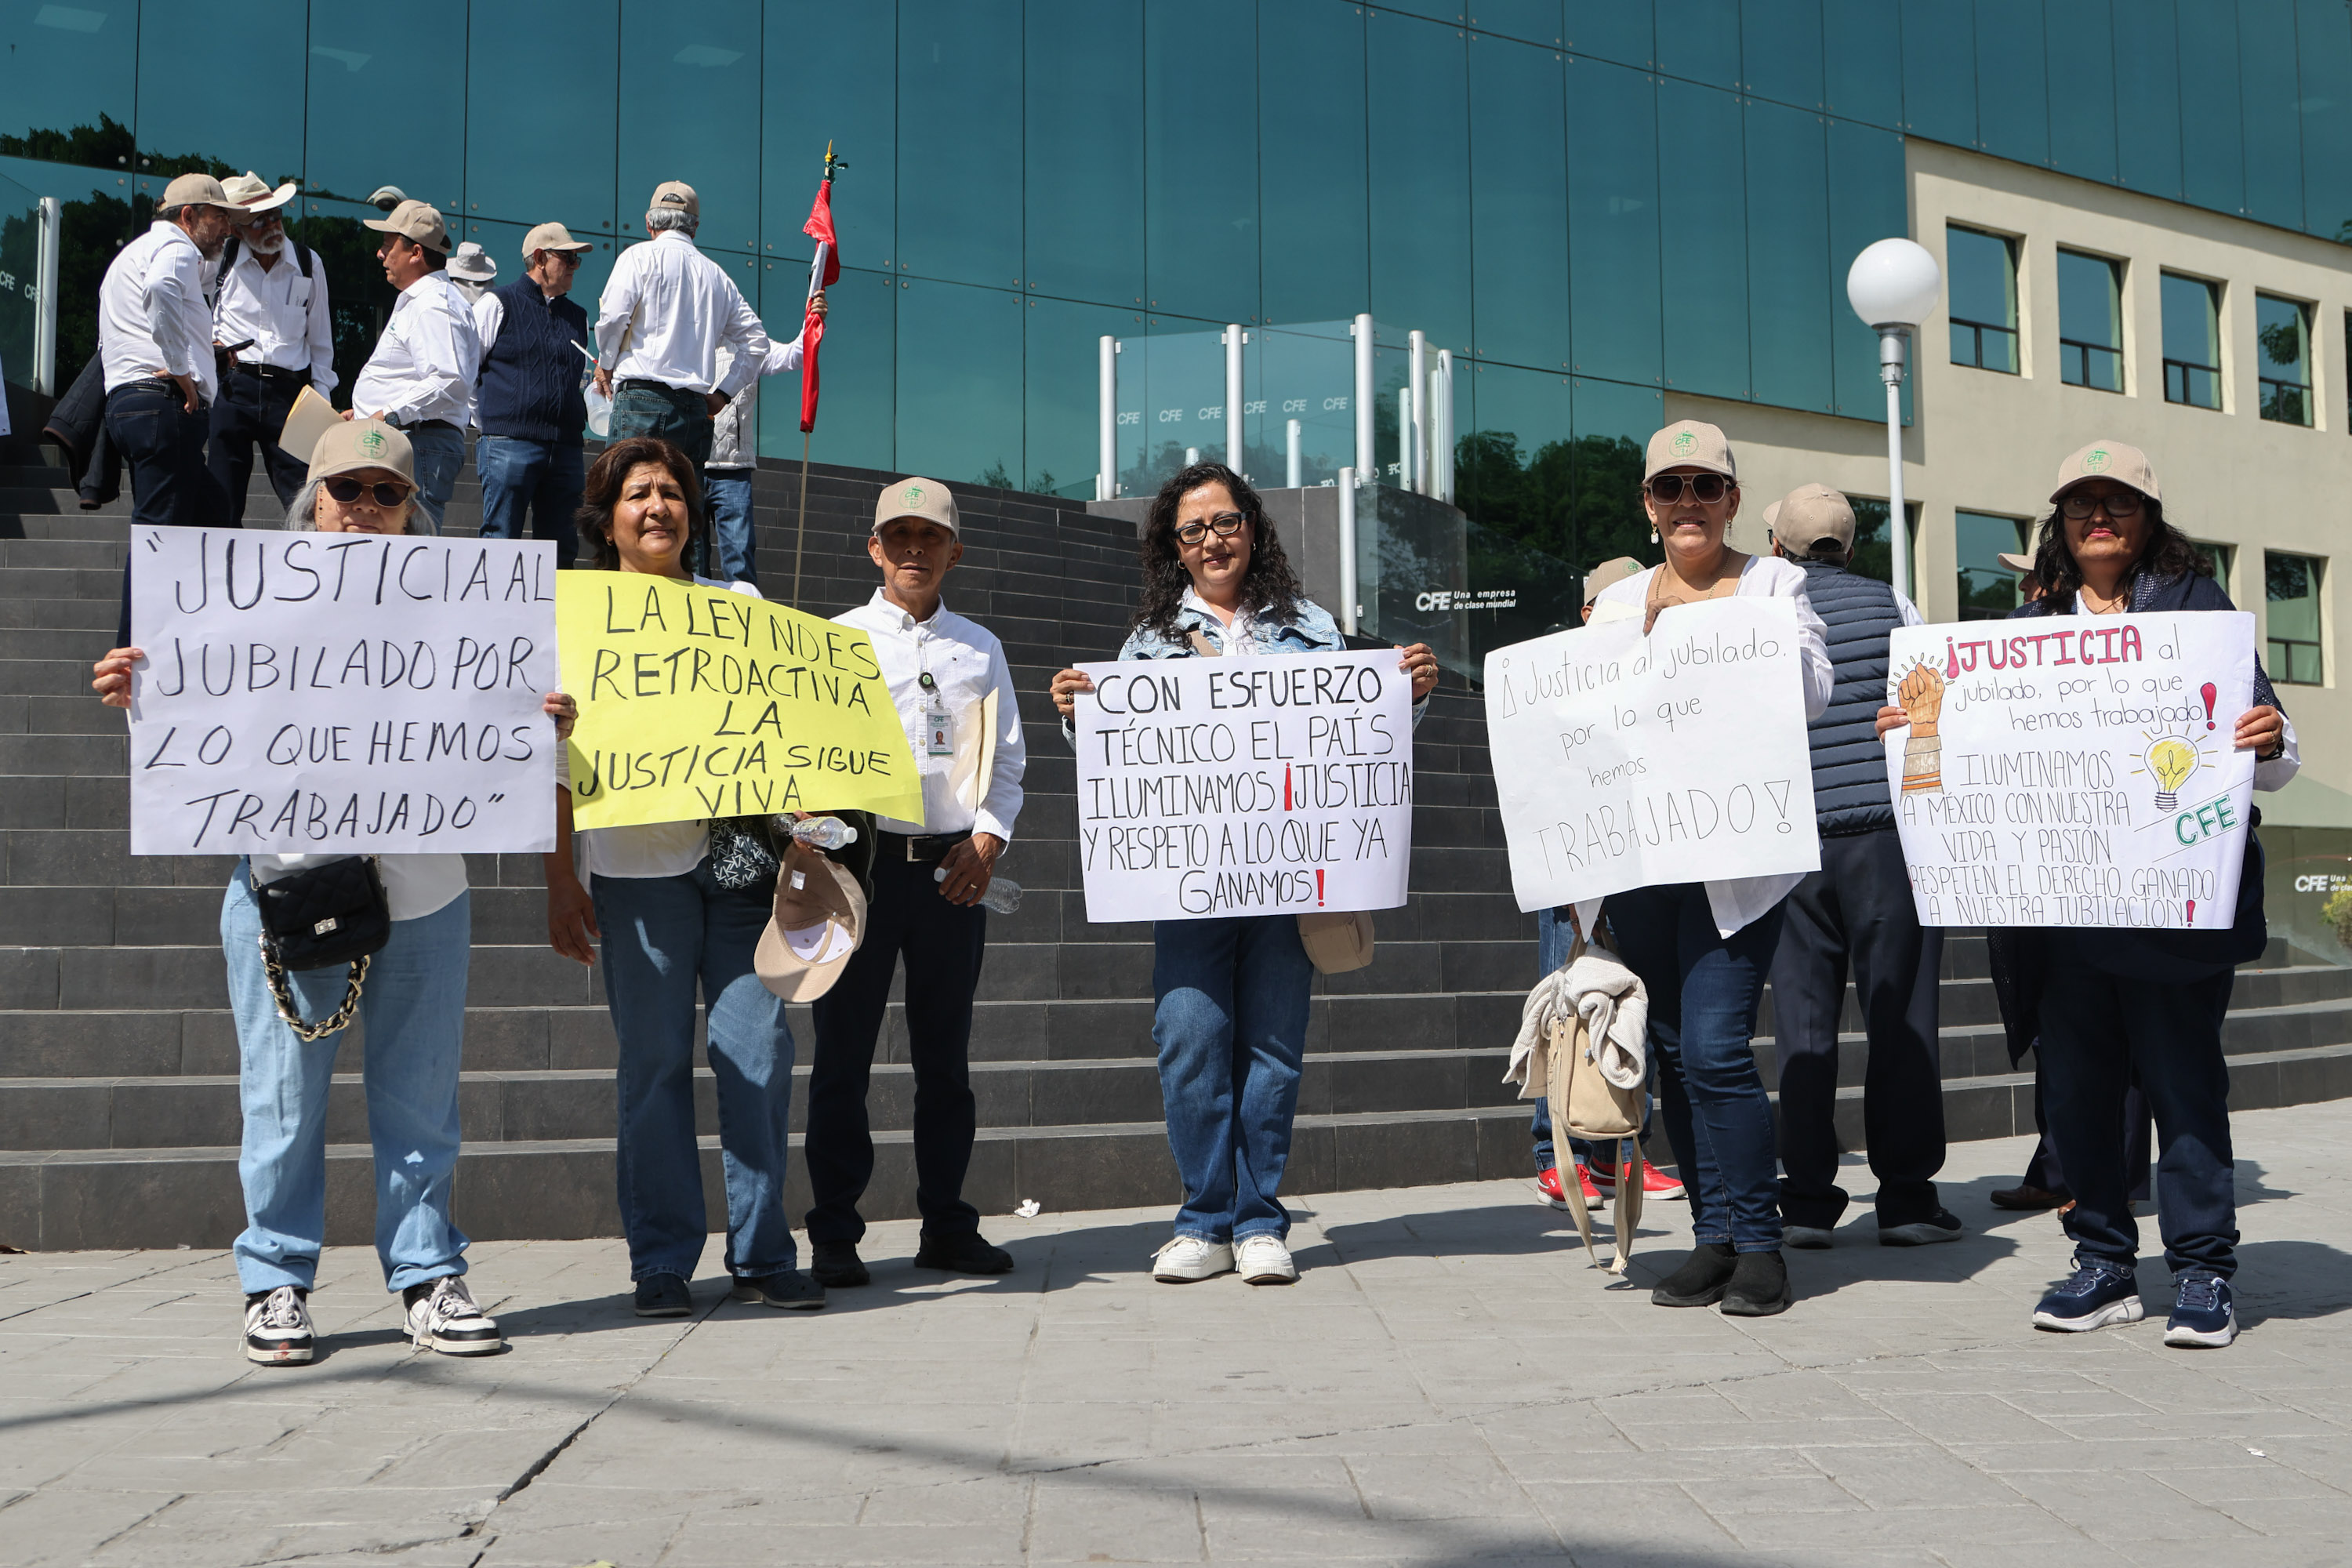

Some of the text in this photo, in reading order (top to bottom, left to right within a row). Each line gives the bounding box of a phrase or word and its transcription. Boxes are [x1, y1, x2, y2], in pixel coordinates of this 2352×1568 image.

[1116, 412, 1141, 425] CFE
[1159, 409, 1183, 423] CFE
[1198, 406, 1222, 420] CFE
[1243, 401, 1267, 414] CFE
[1283, 399, 1307, 412] CFE
[1323, 397, 1348, 410] CFE
[1675, 437, 1691, 445] CFE
[2087, 454, 2103, 463] CFE
[504, 551, 555, 603] AL
[1454, 590, 1515, 600] Una empresa
[1415, 591, 1452, 612] CFE
[1454, 599, 1516, 610] de clase mundial
[606, 586, 666, 633] LA
[686, 593, 752, 647] LEY
[826, 632, 880, 680] ES
[2158, 623, 2181, 661] al
[157, 637, 537, 696] JUBILADO POR
[1633, 636, 1653, 674] al
[590, 646, 871, 717] RETROACTIVA
[1097, 665, 1382, 714] CON ESFUERZO
[2057, 677, 2097, 702] por
[2107, 667, 2129, 694] lo
[2142, 675, 2183, 702] que
[713, 700, 783, 739] LA
[1095, 708, 1394, 766] TÉCNICO EL PAÍS
[1559, 697, 1703, 760] por lo que
[2009, 706, 2082, 731] hemos
[145, 720, 533, 769] LO QUE HEMOS
[578, 740, 891, 797] JUSTICIA SIGUE
[1587, 757, 1646, 788] hemos
[1956, 750, 2114, 789] ILUMINAMOS
[695, 774, 802, 816] VIVA
[1087, 771, 1276, 820] ILUMINAMOS
[1904, 791, 2131, 826] A MÉXICO CON NUESTRA
[2175, 794, 2238, 848] CFE
[1083, 818, 1387, 871] Y RESPETO A LO QUE YA
[1941, 825, 2111, 865] VIDA Y PASIÓN
[2007, 865, 2028, 895] EL
[2038, 865, 2122, 898] DERECHO
[2131, 868, 2215, 901] GANADO
[2295, 875, 2328, 892] CFE
[1929, 896, 1941, 924] A
[1955, 895, 2044, 925] NUESTRA
